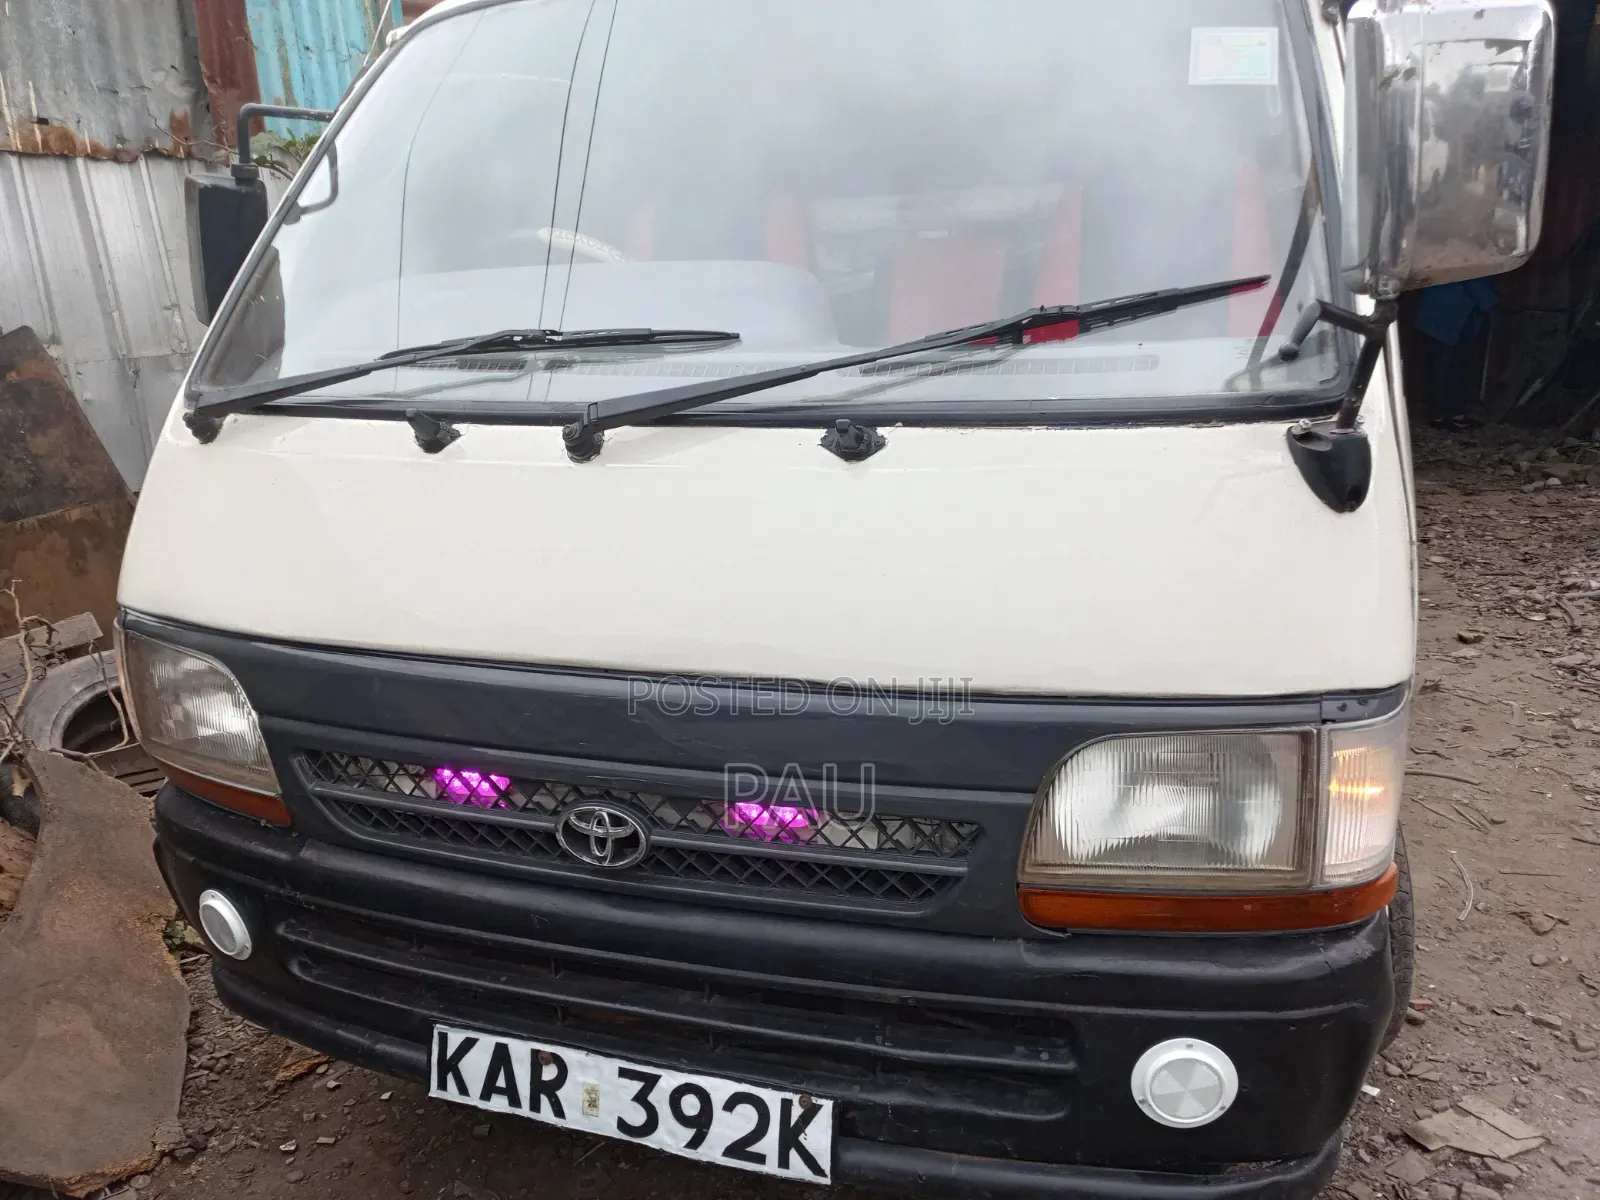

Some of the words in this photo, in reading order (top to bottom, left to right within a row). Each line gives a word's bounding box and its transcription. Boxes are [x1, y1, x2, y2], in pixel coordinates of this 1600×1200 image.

[546, 228, 608, 252] TOYOT
[437, 1031, 568, 1120] KAR
[616, 1067, 828, 1179] 392K
